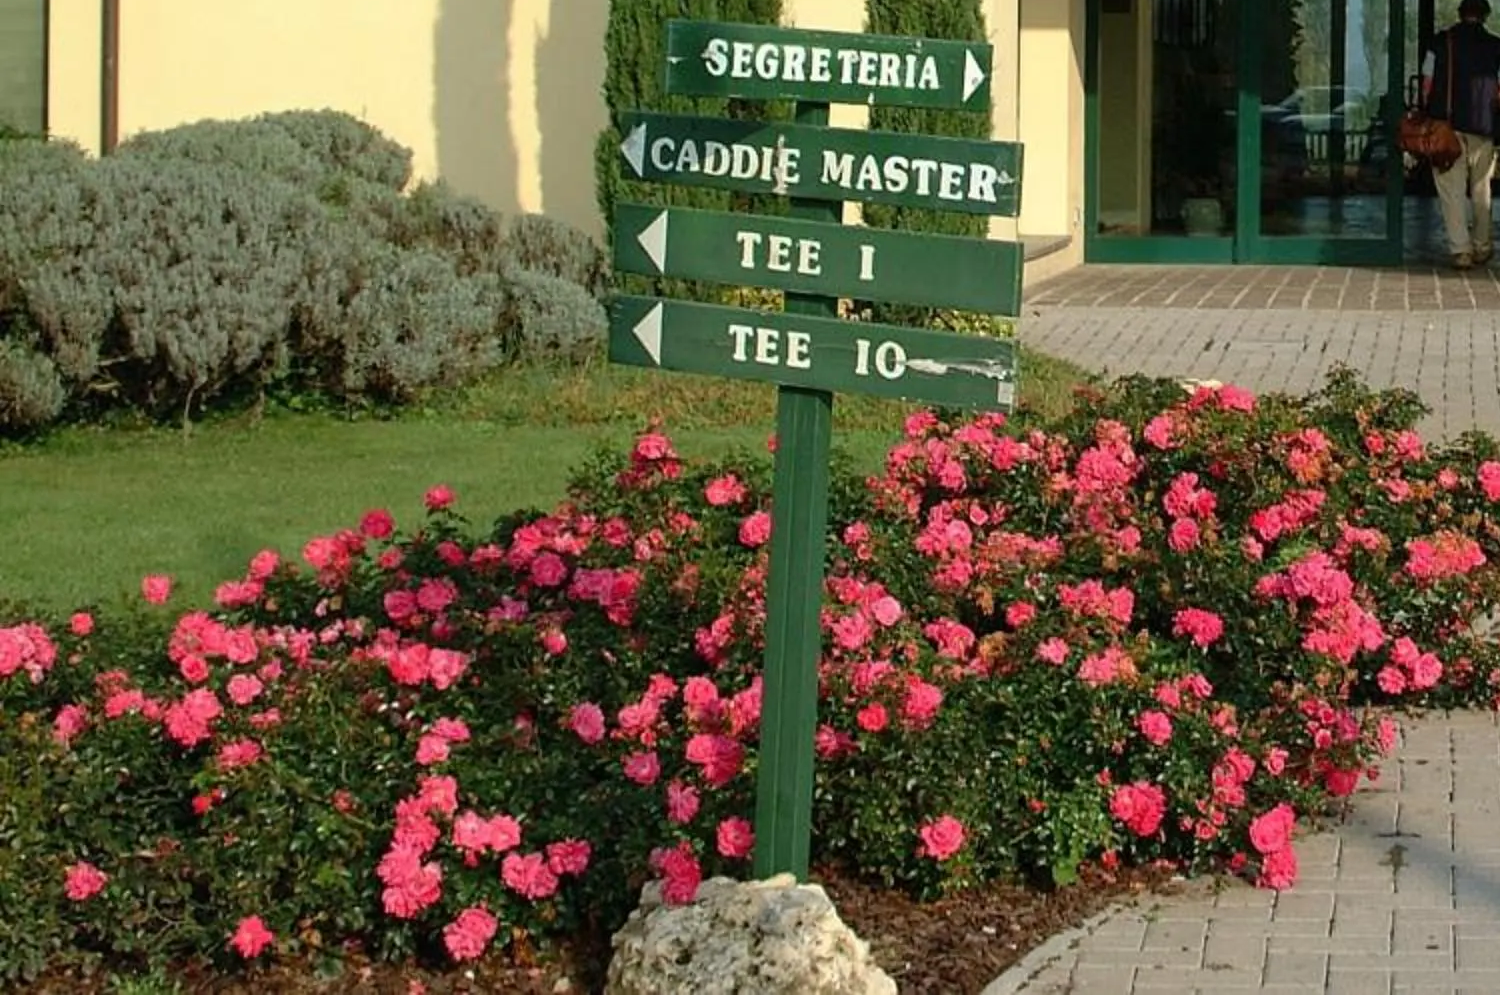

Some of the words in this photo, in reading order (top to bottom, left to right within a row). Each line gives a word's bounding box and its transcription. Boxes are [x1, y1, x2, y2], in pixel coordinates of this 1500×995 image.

[704, 39, 940, 90] SEGRETERIA
[651, 137, 800, 185] CADDIE
[821, 151, 999, 203] MASTER
[737, 231, 821, 275] TEE
[729, 325, 811, 368] TEE
